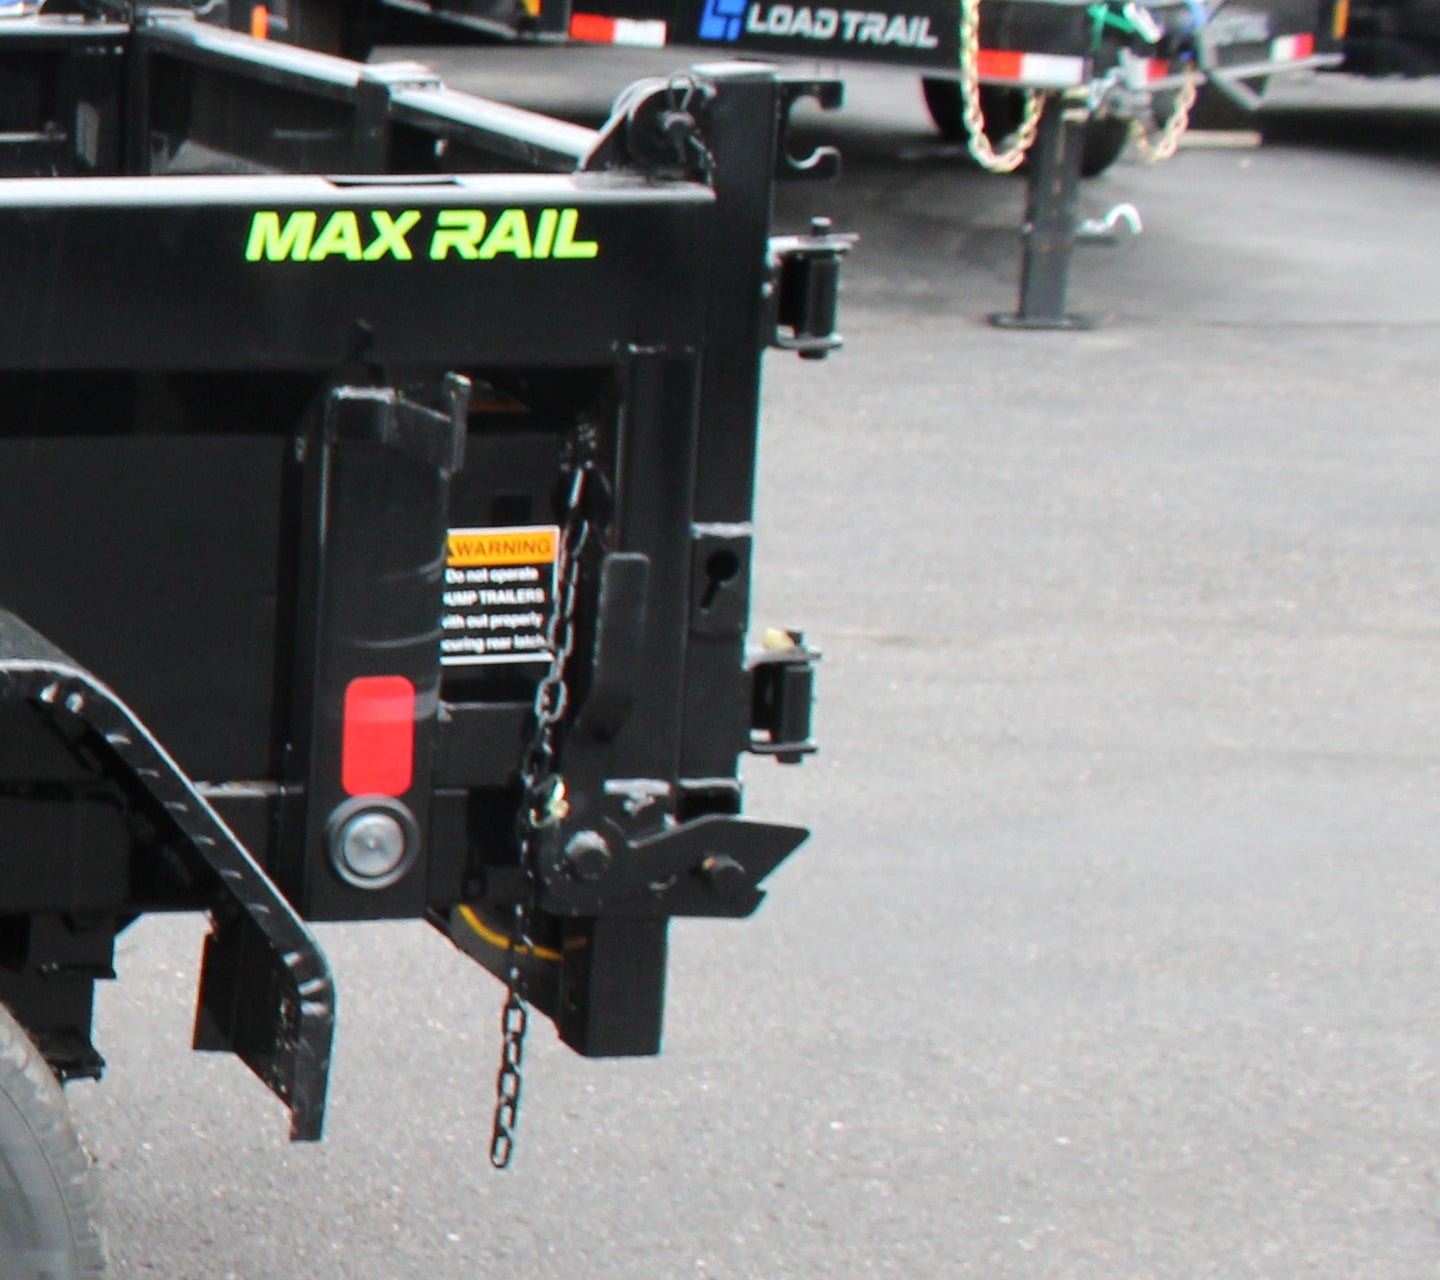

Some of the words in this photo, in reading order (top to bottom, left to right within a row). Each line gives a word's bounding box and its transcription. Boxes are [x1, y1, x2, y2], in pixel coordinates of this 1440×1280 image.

[746, 2, 838, 39] LOAD
[842, 9, 939, 48] TRAIL
[245, 210, 416, 262] MAX
[430, 208, 599, 260] RAIL
[455, 539, 551, 557] WARNING
[466, 567, 489, 583] not
[490, 566, 539, 584] operate
[479, 587, 545, 605] TRAILERS
[490, 610, 543, 630] properly
